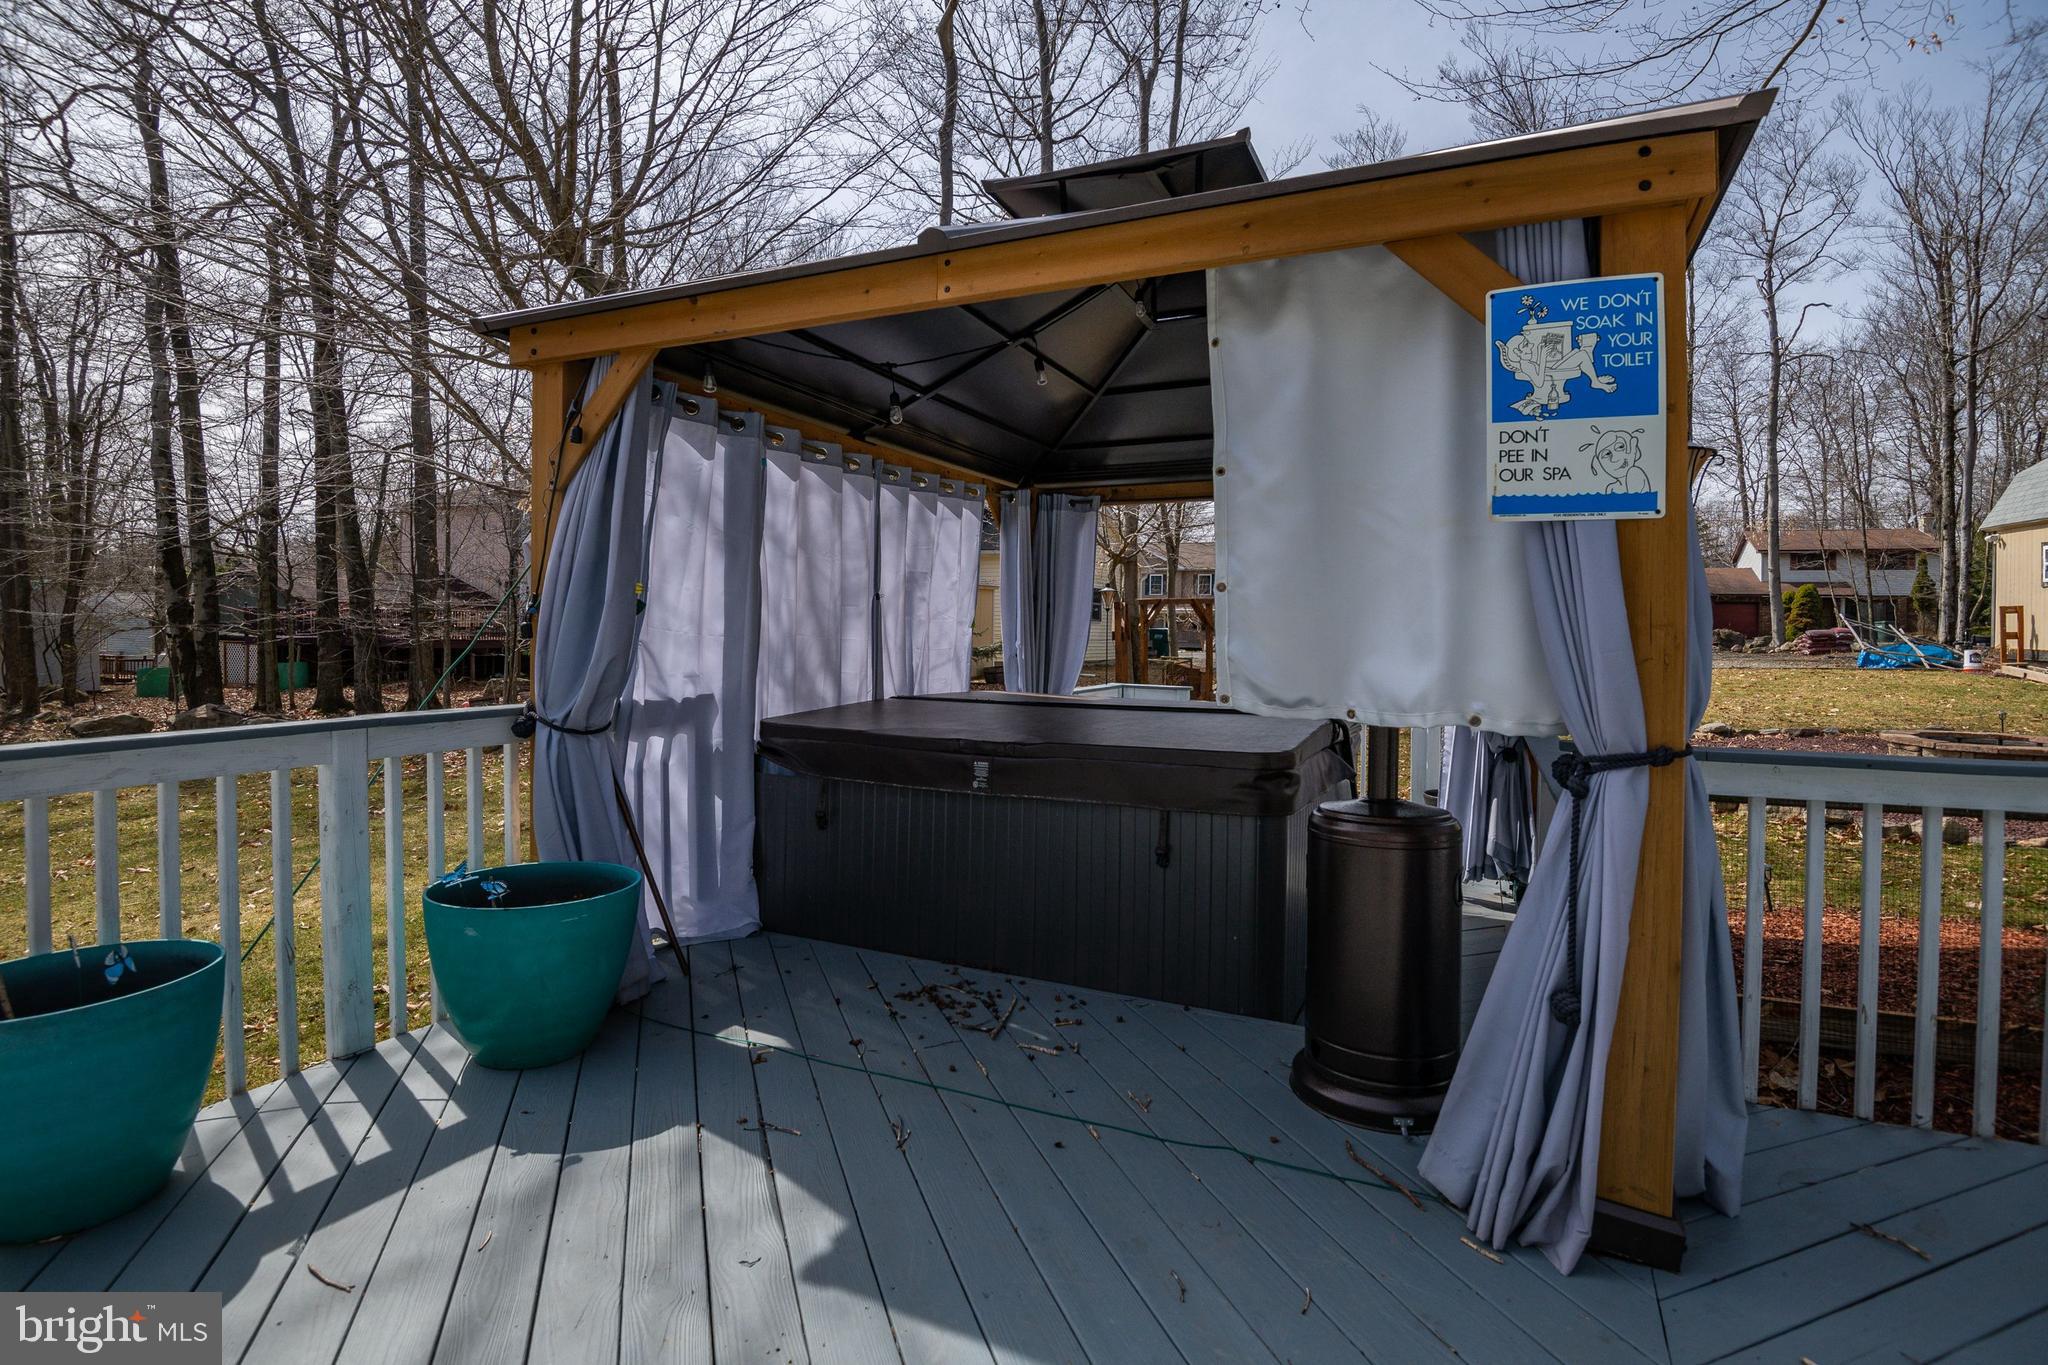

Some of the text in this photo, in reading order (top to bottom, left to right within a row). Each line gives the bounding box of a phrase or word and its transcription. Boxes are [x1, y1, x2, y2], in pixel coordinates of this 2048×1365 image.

[1560, 289, 1652, 312] WE DON'T
[1576, 311, 1653, 330] SOAK IN
[1608, 331, 1653, 348] YOUR
[1601, 351, 1653, 368] TOILET
[1499, 426, 1549, 444] DON'T
[1499, 448, 1548, 463] PEE IN
[1499, 468, 1534, 482] OUR
[1542, 466, 1572, 481] SPA
